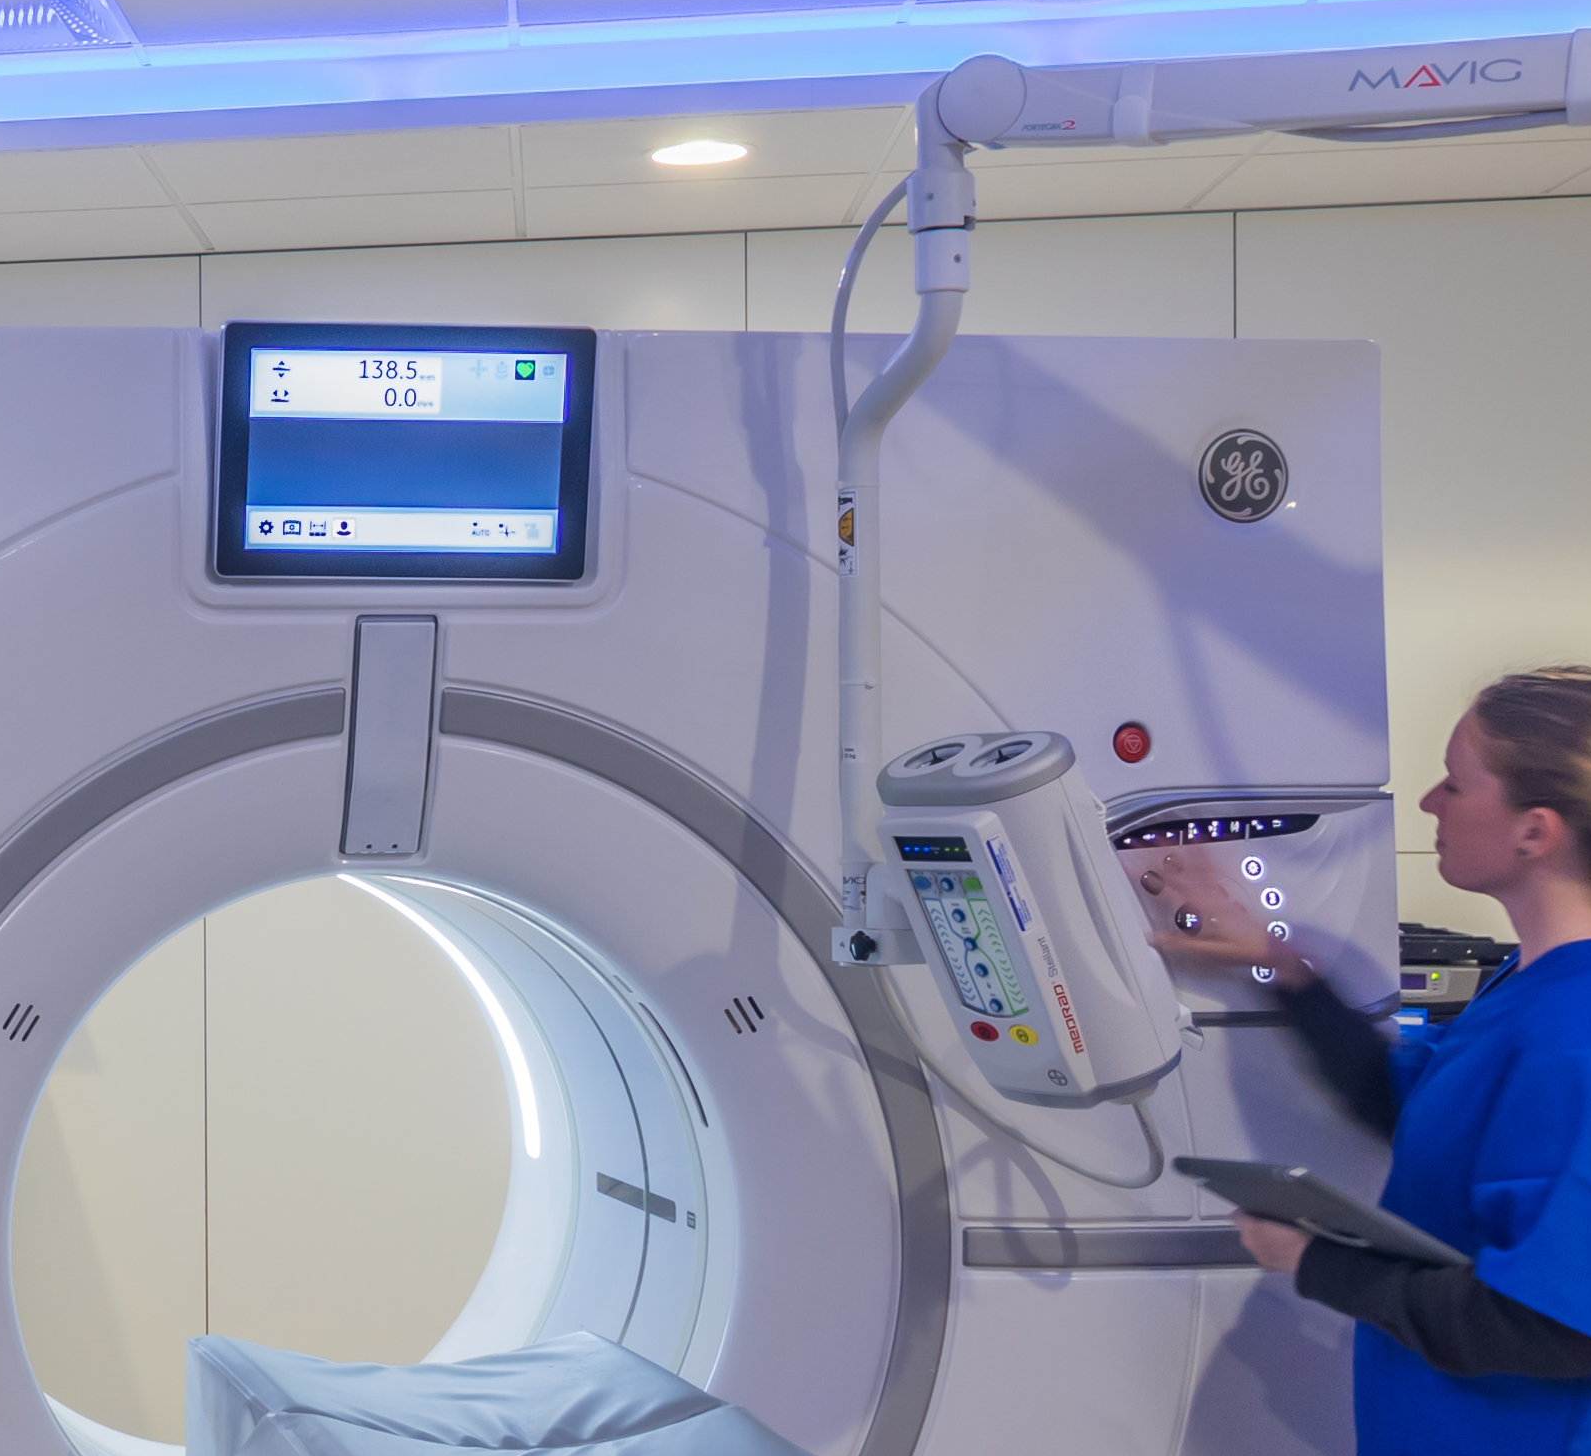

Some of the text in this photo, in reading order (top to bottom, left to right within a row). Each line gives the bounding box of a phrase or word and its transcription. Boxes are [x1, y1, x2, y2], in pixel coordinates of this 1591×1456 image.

[1348, 58, 1523, 92] MAVIG
[358, 359, 417, 380] 138.5
[384, 387, 417, 407] 0.0
